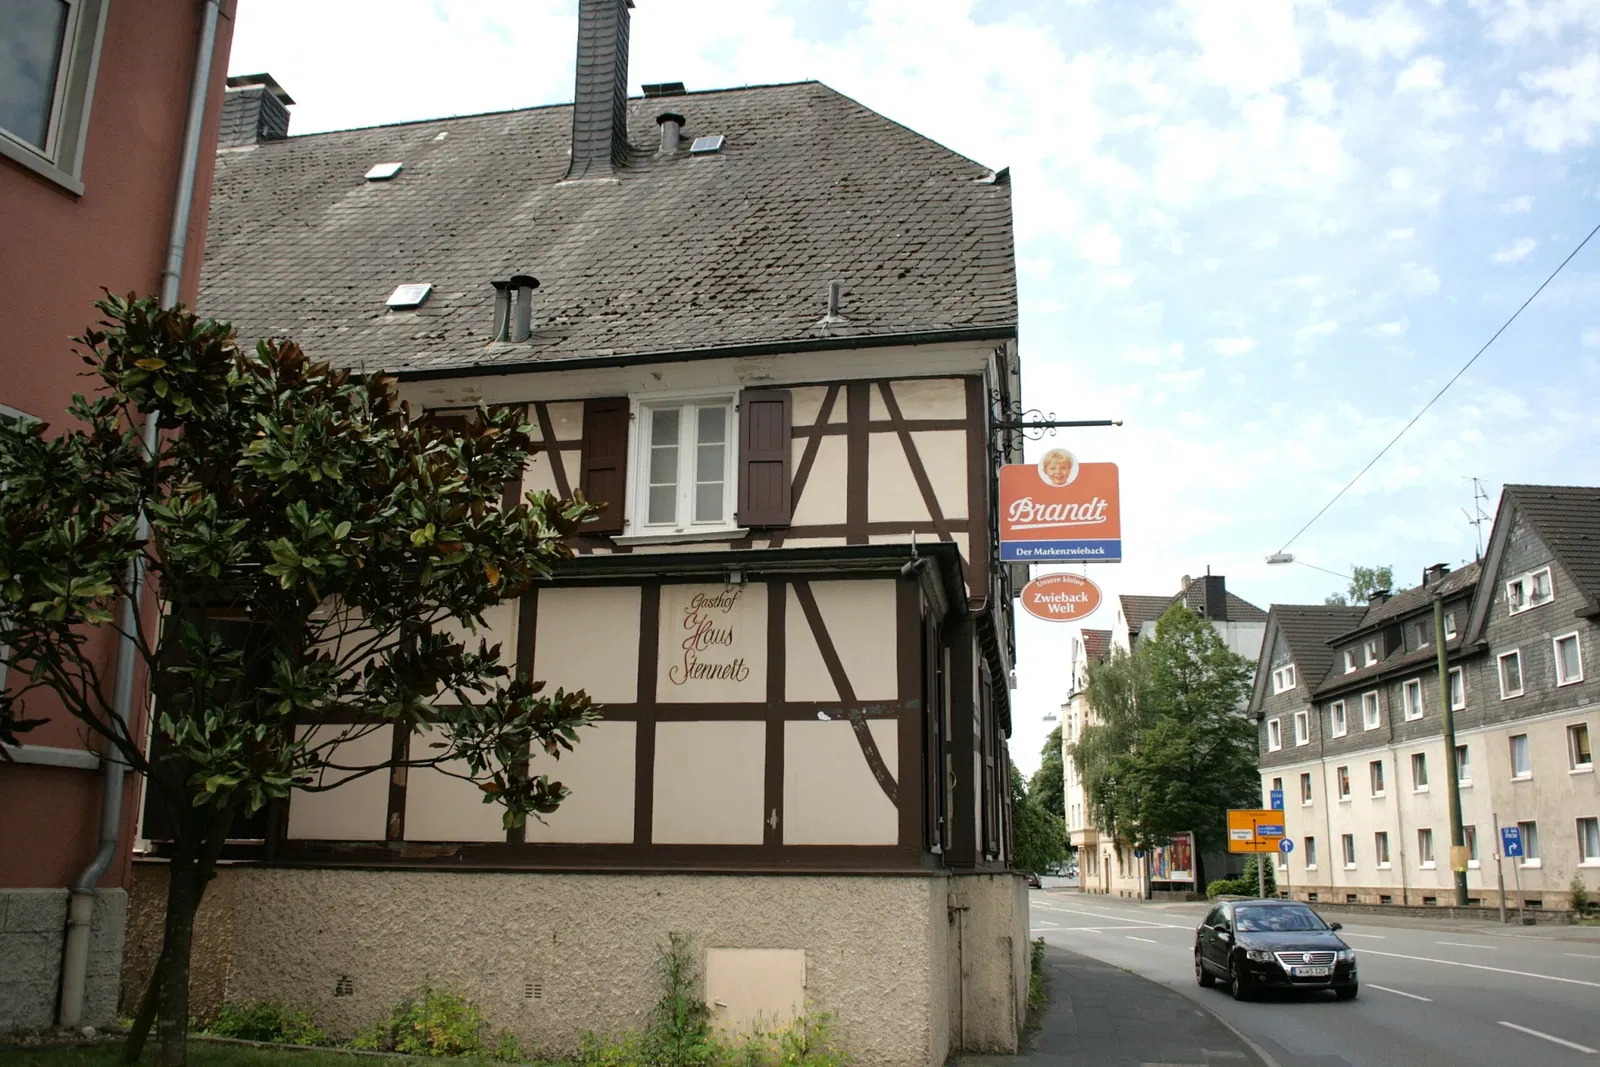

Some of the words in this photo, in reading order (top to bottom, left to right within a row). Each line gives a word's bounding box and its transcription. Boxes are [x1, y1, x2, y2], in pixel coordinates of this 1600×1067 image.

[1008, 497, 1108, 530] Brandt
[1016, 548, 1032, 556] Der
[1034, 546, 1105, 556] Markenzwieback
[1036, 577, 1062, 587] Unsere
[1062, 576, 1085, 587] kleine
[684, 590, 742, 614] Gasthof
[1034, 592, 1088, 603] Zwieback
[1048, 603, 1075, 613] Welt
[682, 613, 733, 652] Haus
